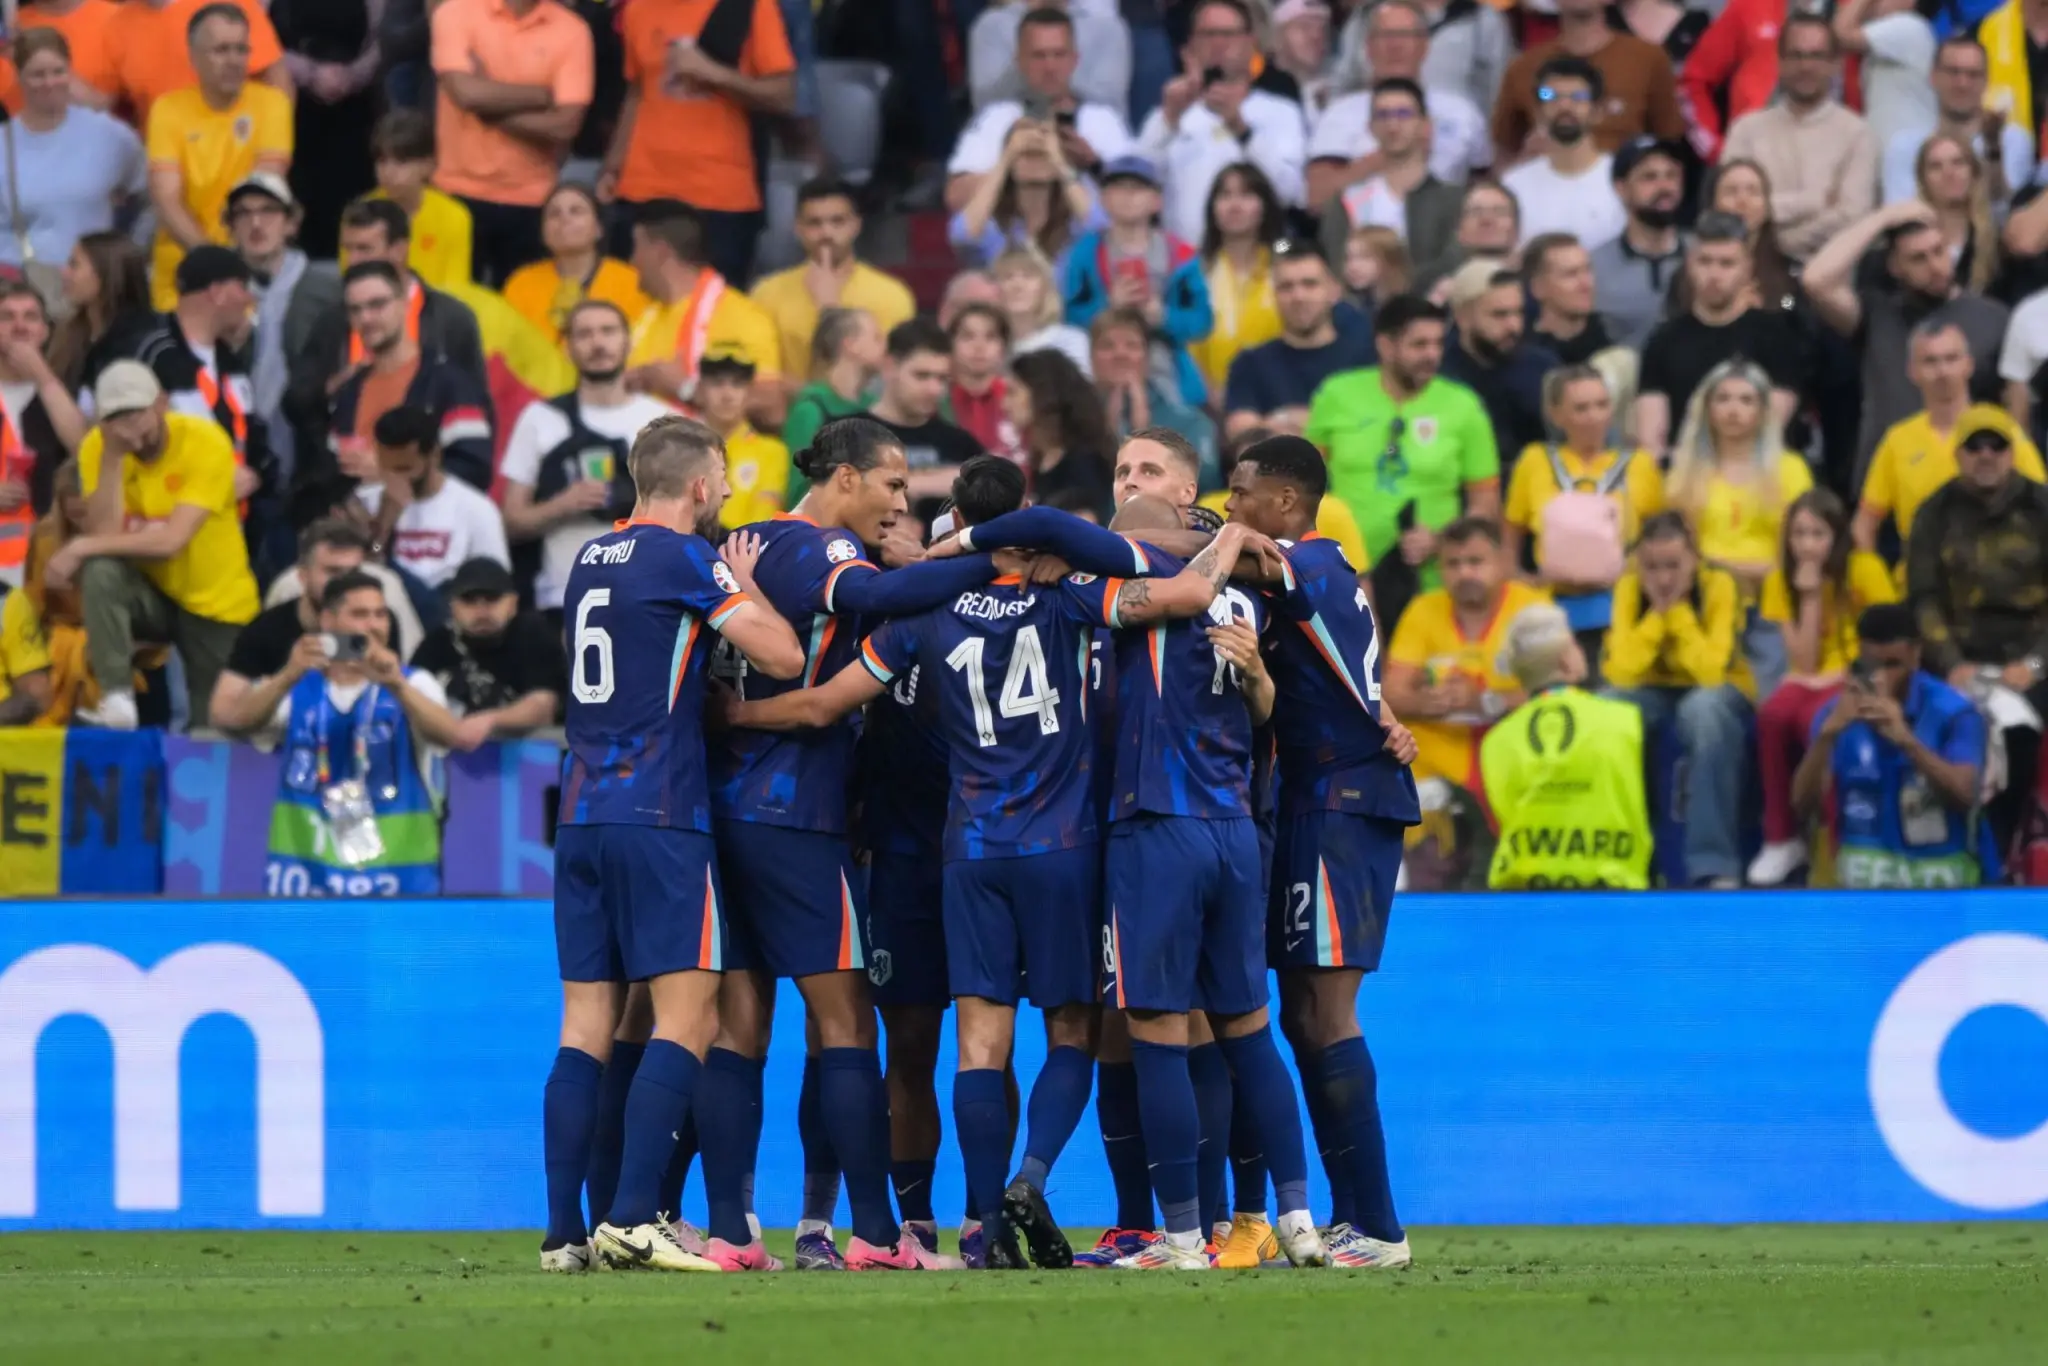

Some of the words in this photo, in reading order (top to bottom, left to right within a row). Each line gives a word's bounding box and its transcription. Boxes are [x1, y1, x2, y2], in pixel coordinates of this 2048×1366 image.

[572, 588, 615, 703] 6
[945, 624, 1061, 748] 14
[0, 941, 325, 1218] m
